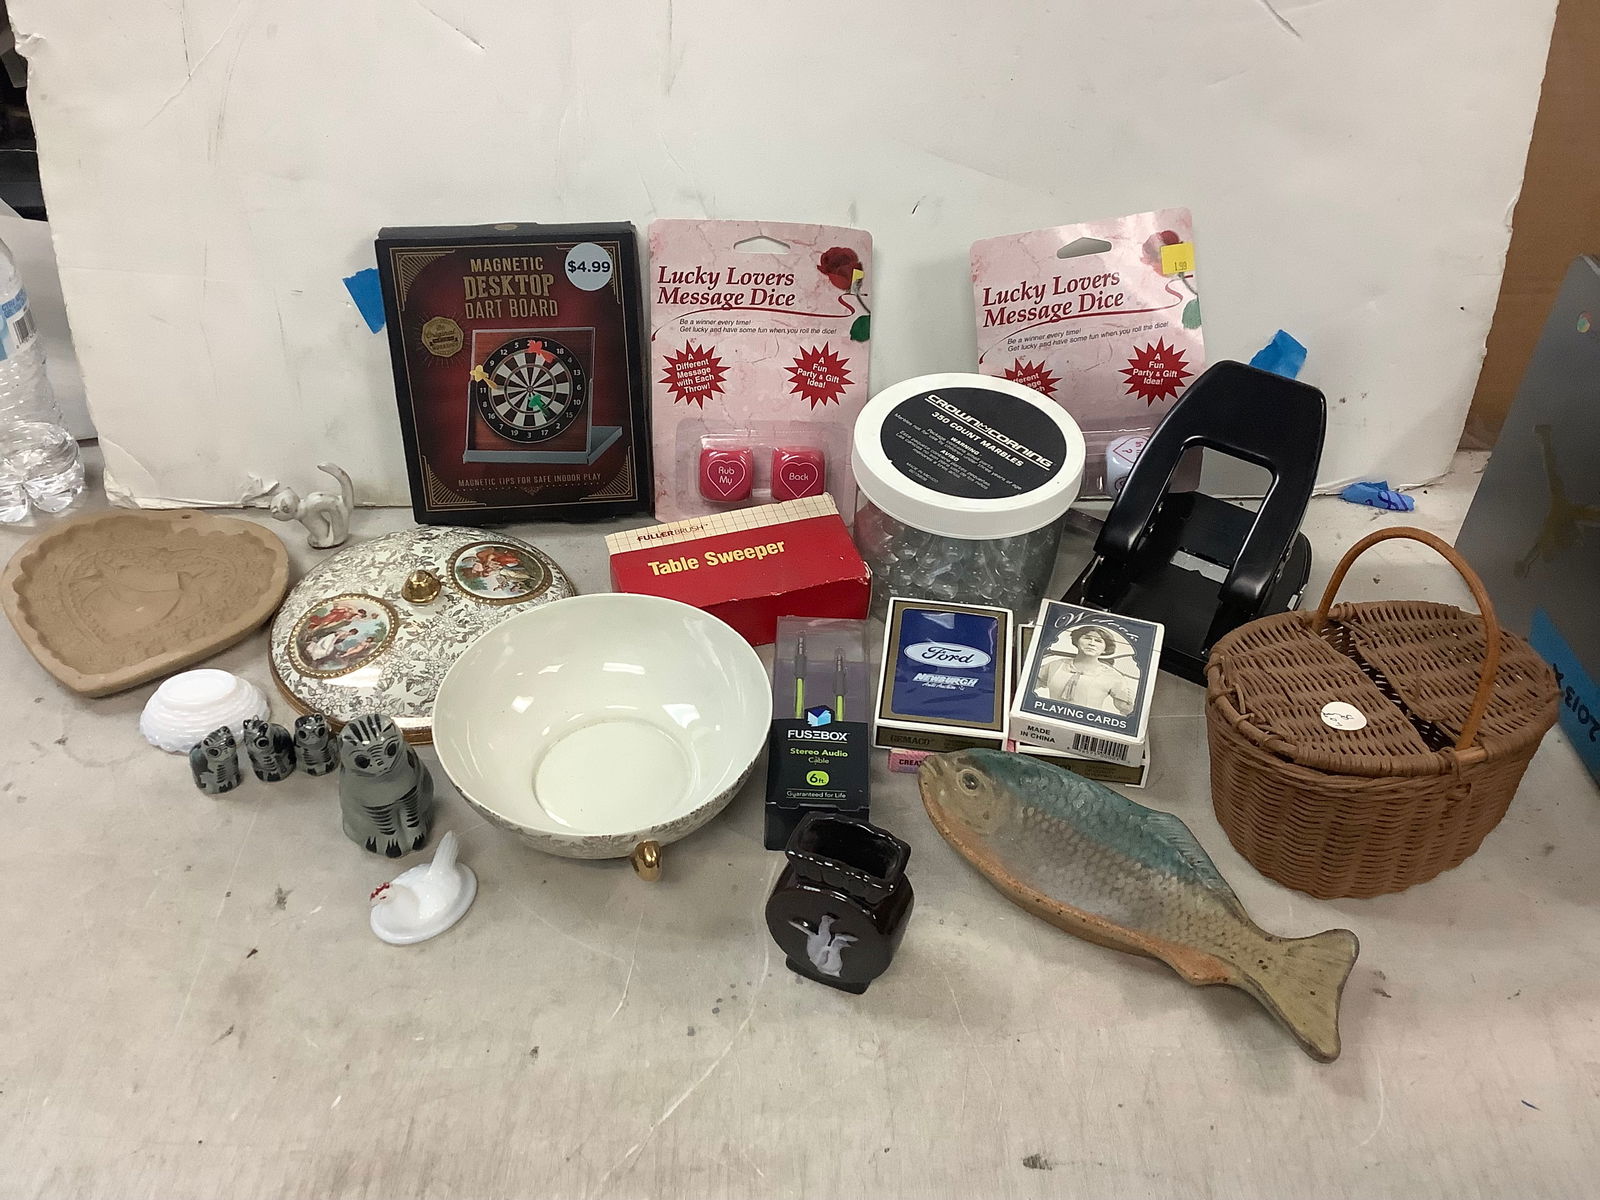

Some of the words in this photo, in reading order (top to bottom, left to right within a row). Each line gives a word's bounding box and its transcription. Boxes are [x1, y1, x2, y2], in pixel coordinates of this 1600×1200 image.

[470, 257, 543, 272] MAGNETIC
[568, 260, 610, 273] $4.99
[658, 266, 720, 290] Lucky
[727, 267, 795, 286] Lovers
[463, 274, 554, 300] DESKTOP
[982, 281, 1045, 306] Lucky
[1052, 272, 1120, 295] Lovers
[657, 286, 744, 308] Message
[750, 288, 795, 306] Dice
[465, 300, 502, 319] DART
[510, 300, 558, 318] BOARD
[983, 301, 1072, 328] Message
[1079, 292, 1124, 313] Dice
[1021, 343, 1038, 351] lucky
[1101, 331, 1117, 339] when
[1118, 329, 1131, 337] you
[1132, 325, 1142, 333] roll
[1155, 321, 1168, 329] dice!
[1024, 334, 1045, 342] winner
[1066, 328, 1081, 336] time!
[675, 359, 708, 369] Different
[677, 367, 710, 378] Message
[797, 368, 816, 379] Party
[825, 374, 839, 382] Gift
[1132, 368, 1153, 377] Party
[1162, 369, 1177, 377] Gift
[676, 378, 692, 386] with
[695, 374, 714, 382] Each
[807, 379, 825, 387] Idea!
[684, 383, 710, 392] Throw!
[927, 394, 981, 426] CROWN
[987, 427, 1054, 468] CORNING
[931, 411, 950, 423] 350
[949, 422, 980, 441] COUNT
[980, 439, 1023, 466] MARBLES
[950, 437, 979, 454] WARNING
[940, 449, 959, 461] AVISO
[718, 466, 734, 475] Rub
[789, 472, 808, 481] Back
[458, 478, 495, 486] MAGNETIC
[517, 476, 531, 484] FOR
[554, 474, 581, 483] INDOOR
[584, 473, 601, 481] PLAY
[720, 476, 733, 485] My
[648, 557, 699, 576] Table
[704, 541, 785, 567] Sweeper
[922, 647, 974, 663] Ford
[913, 673, 979, 687] NEWBURGH
[1034, 701, 1084, 719] PLAYING
[1086, 712, 1127, 729] CARDS
[788, 730, 847, 741] FUSEBOX
[1027, 725, 1050, 735] MADE
[1031, 731, 1056, 744] CHINA
